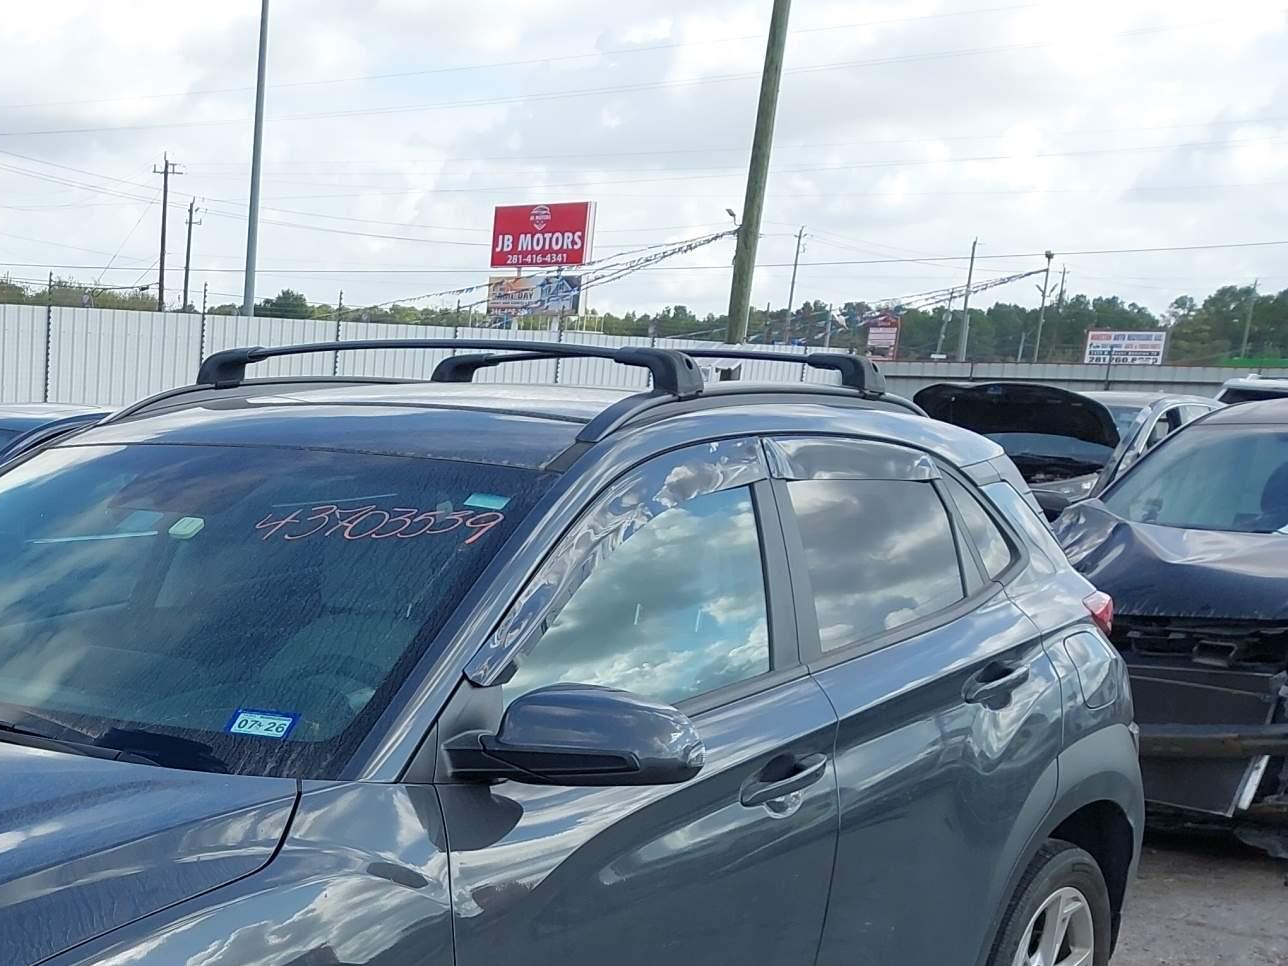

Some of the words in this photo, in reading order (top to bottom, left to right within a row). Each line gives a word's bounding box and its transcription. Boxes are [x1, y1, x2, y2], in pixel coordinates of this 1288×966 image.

[495, 234, 513, 252] JB
[517, 231, 582, 251] MOTORS
[506, 253, 567, 264] 281-416-4341
[255, 504, 505, 544] 43703539
[237, 718, 259, 730] 07
[264, 721, 287, 733] 26
